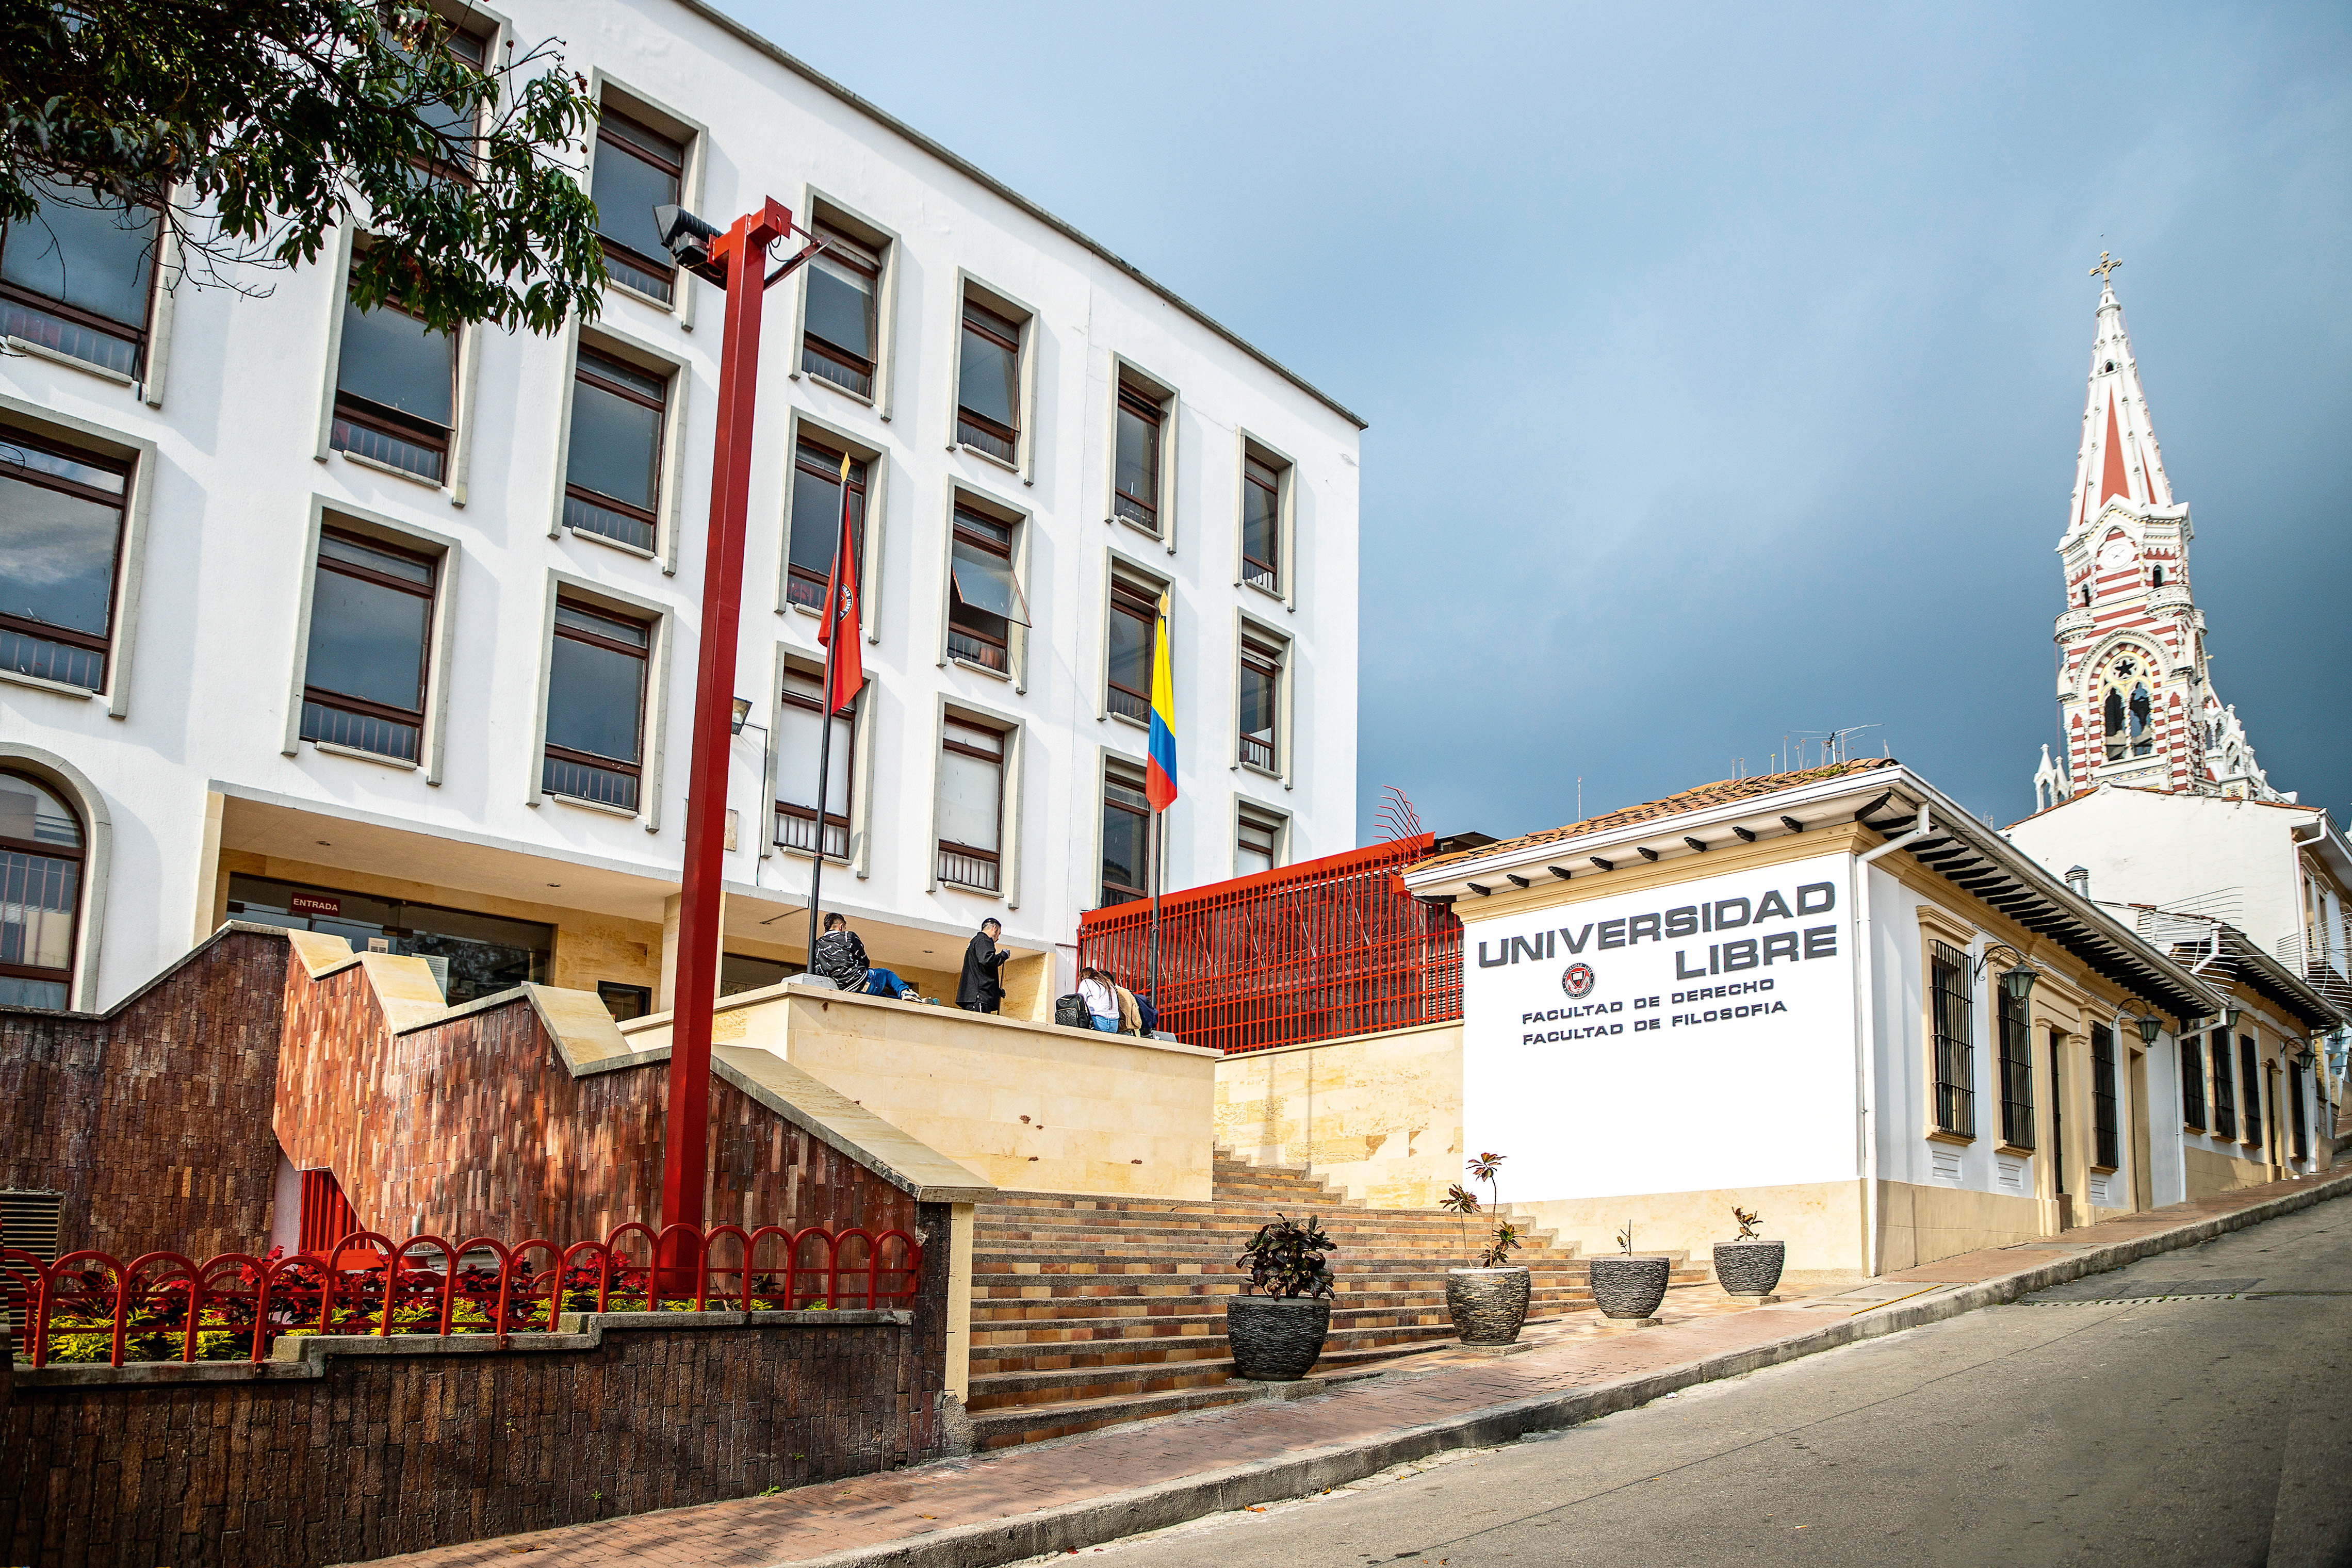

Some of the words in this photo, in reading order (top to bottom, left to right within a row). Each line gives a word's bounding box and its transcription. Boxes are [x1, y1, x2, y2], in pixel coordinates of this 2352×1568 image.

[293, 898, 338, 911] ENTRADA
[1479, 882, 1835, 969] UNIVERSIDAD
[1676, 925, 1837, 981] LIBRE
[1523, 1001, 1623, 1025] FACULTAD
[1634, 996, 1660, 1010] DE
[1672, 978, 1774, 1004] DERECHO
[1523, 1023, 1623, 1046] FACULTAD
[1634, 1018, 1660, 1032] DE
[1672, 1001, 1787, 1027] FILOSOFIA
